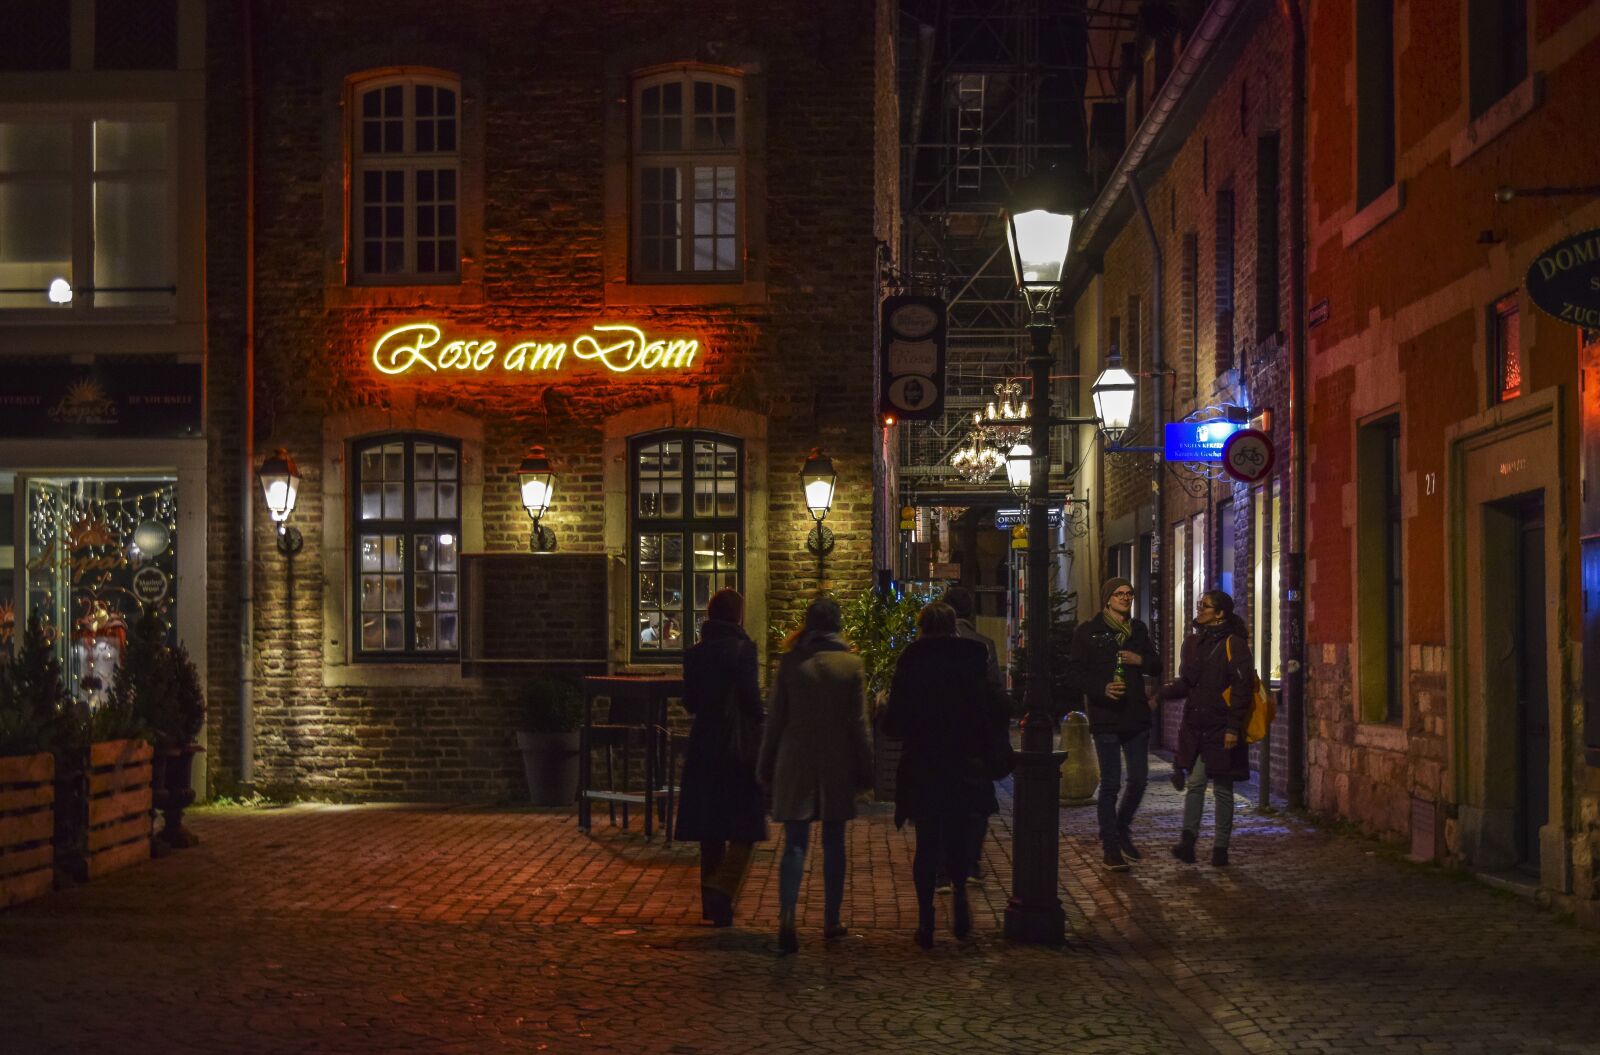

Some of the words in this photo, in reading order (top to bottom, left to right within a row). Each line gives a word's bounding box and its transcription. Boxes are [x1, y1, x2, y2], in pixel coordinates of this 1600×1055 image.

[372, 323, 497, 374] Rose
[503, 341, 567, 371] am
[573, 325, 699, 372] Dom
[1425, 471, 1436, 496] 27
